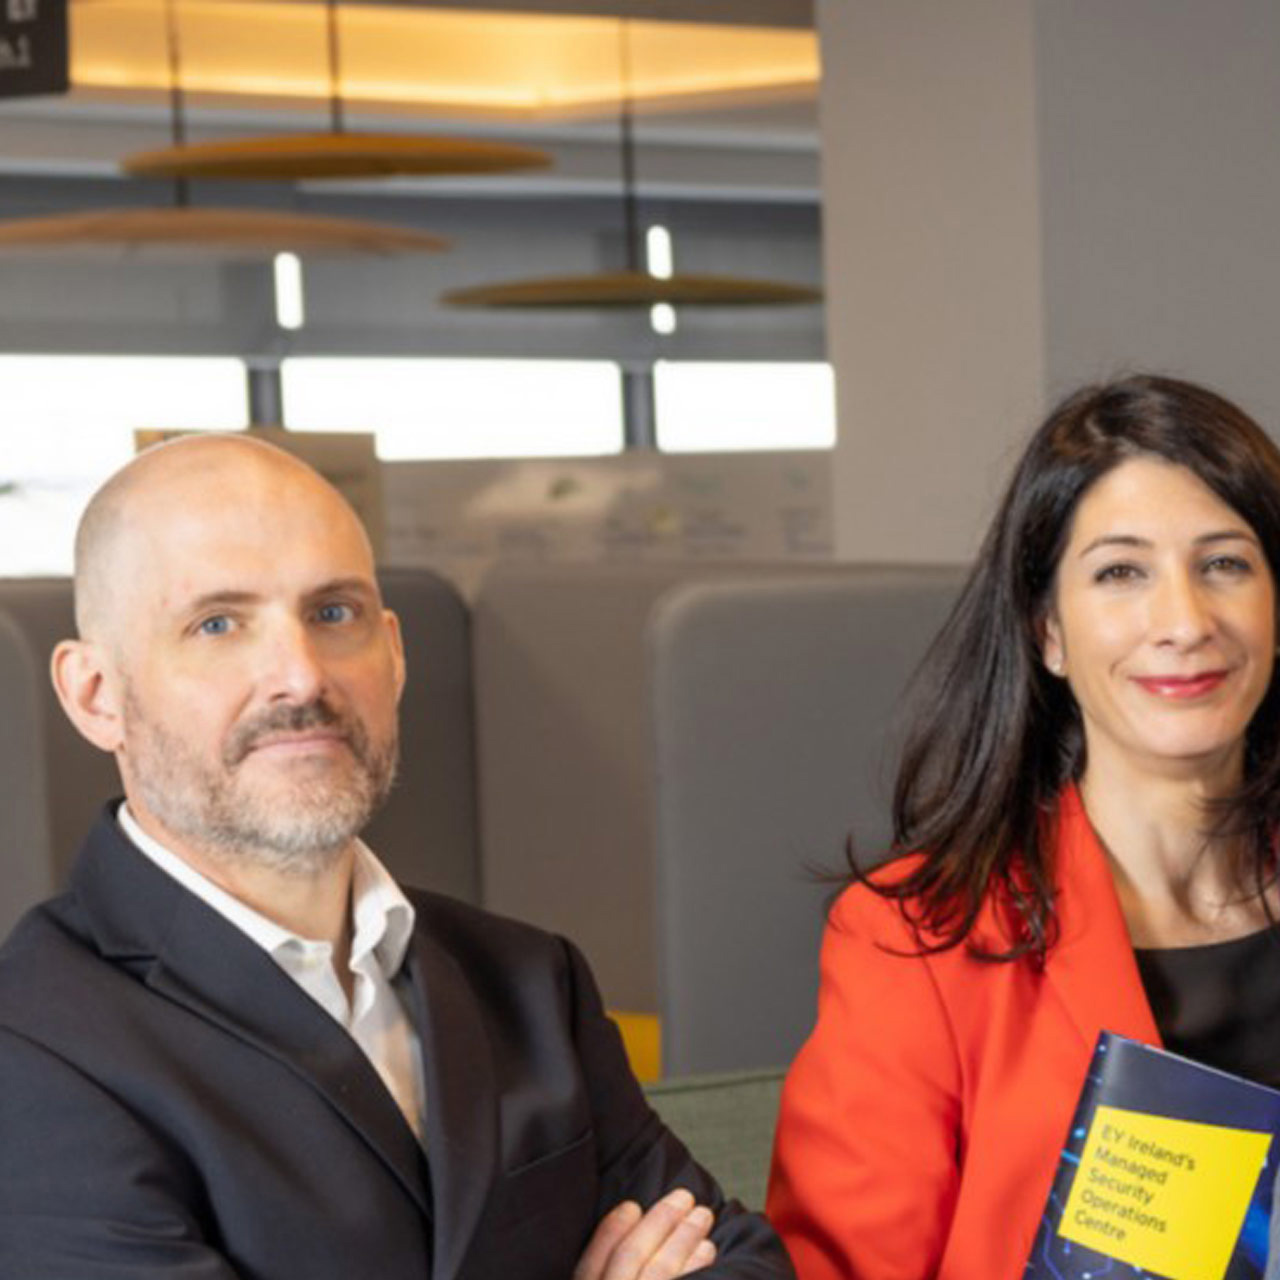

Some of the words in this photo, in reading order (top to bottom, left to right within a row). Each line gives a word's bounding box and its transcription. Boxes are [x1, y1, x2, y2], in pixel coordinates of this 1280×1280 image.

[1095, 1146, 1168, 1185] Managed
[1102, 1124, 1124, 1142] EY
[1128, 1135, 1195, 1171] Ireland's
[1088, 1167, 1155, 1205] Security
[1074, 1209, 1126, 1240] Centre
[1081, 1189, 1167, 1233] Operations
